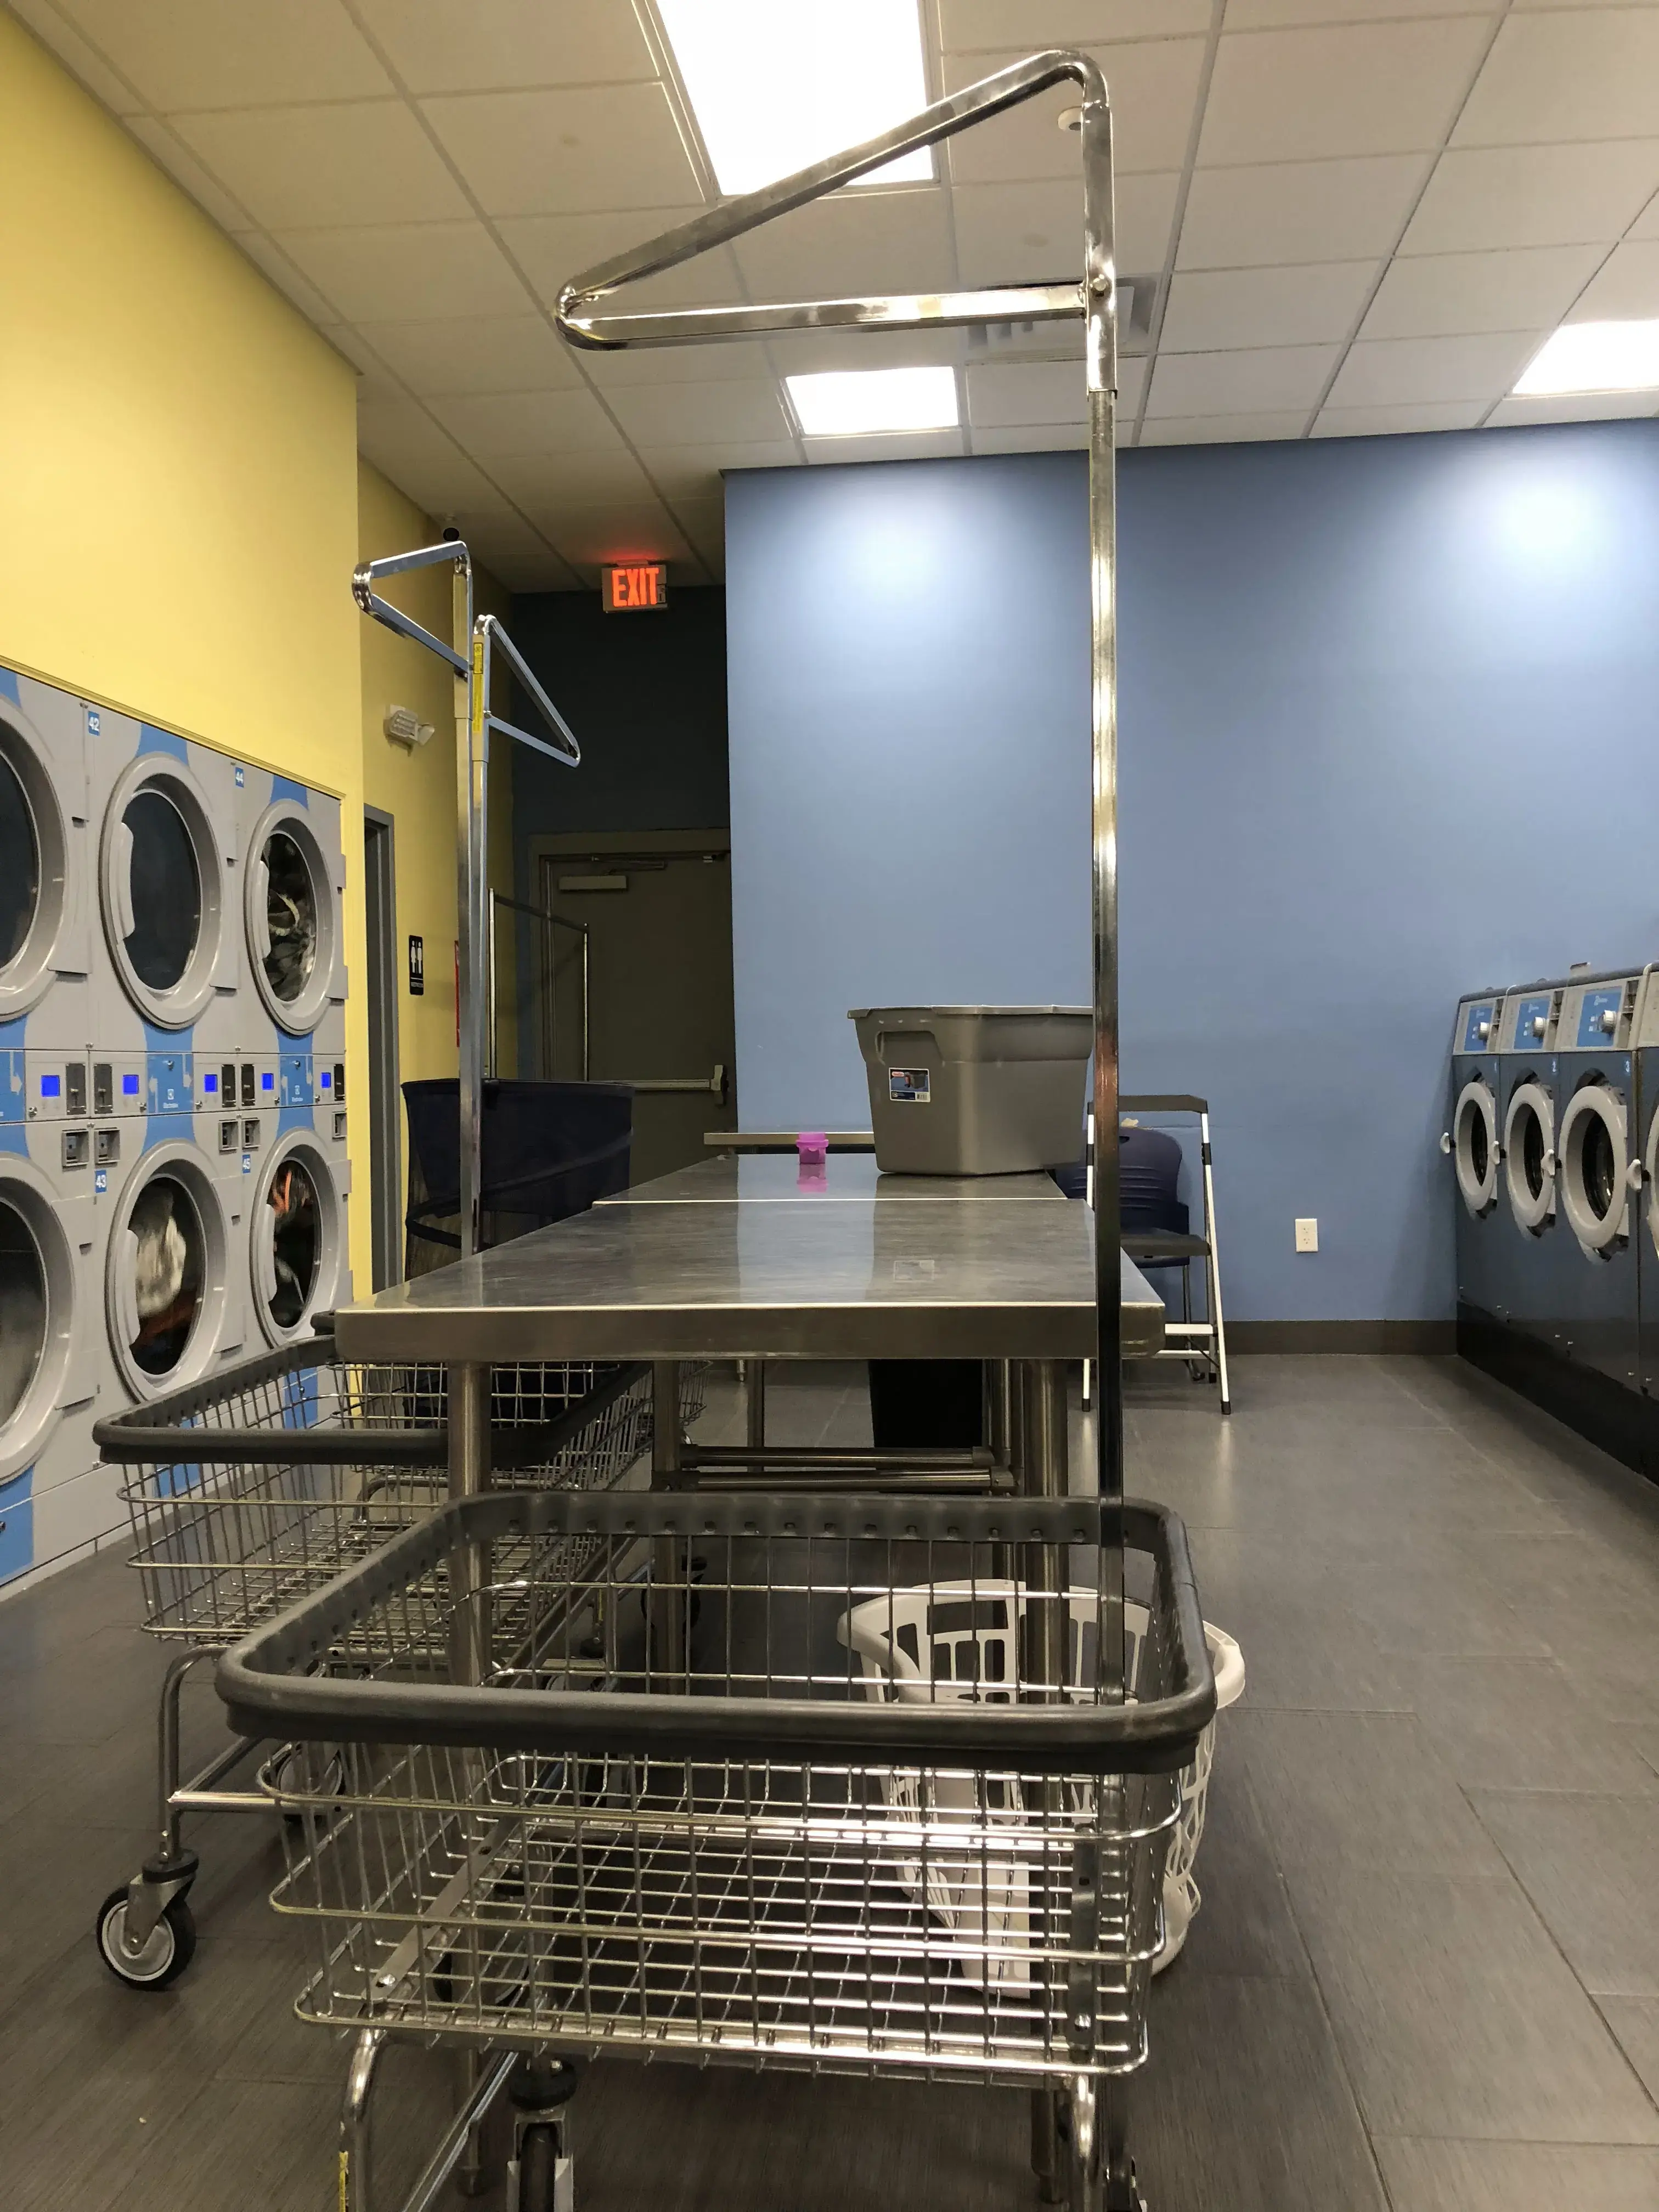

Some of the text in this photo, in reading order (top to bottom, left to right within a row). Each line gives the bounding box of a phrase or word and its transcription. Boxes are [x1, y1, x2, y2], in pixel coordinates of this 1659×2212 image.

[612, 568, 659, 607] EXIT
[89, 716, 99, 732] 42
[236, 771, 243, 784] 44
[243, 1158, 251, 1169] 45
[96, 1175, 106, 1188] 43
